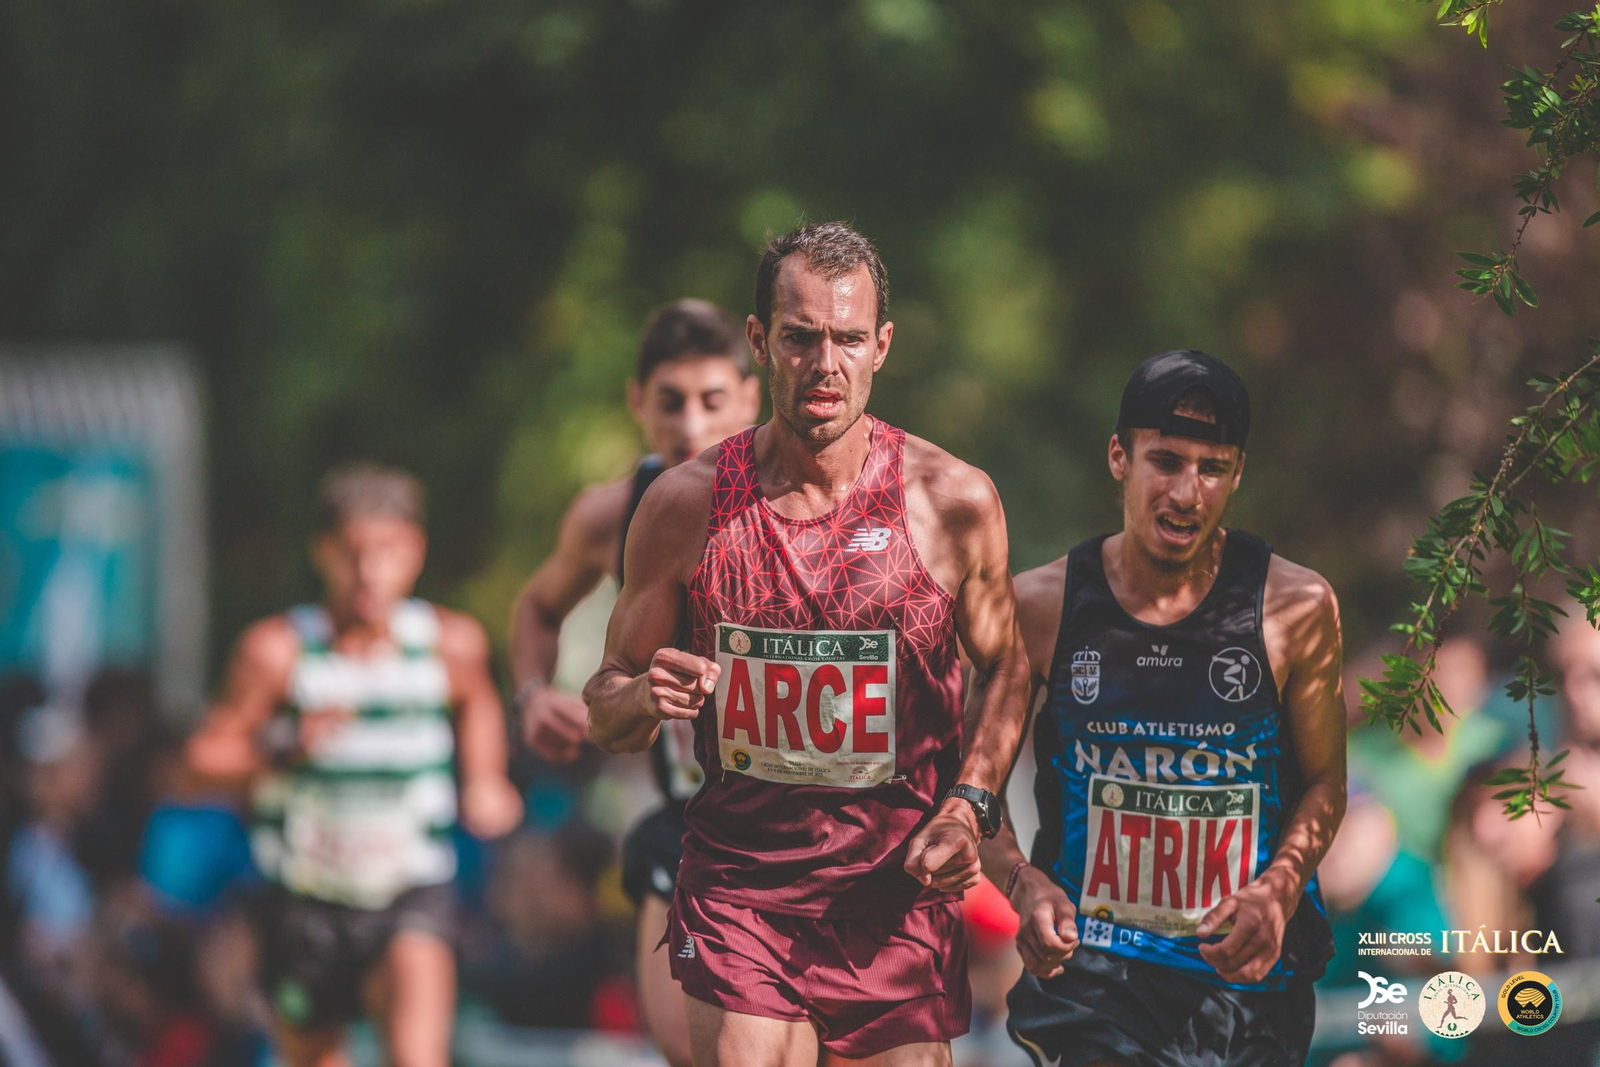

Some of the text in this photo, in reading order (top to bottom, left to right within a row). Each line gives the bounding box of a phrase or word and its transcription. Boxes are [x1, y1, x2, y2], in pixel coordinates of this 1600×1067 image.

[762, 635, 845, 657] ITÁLICA
[1136, 655, 1183, 667] amura
[722, 657, 889, 754] ARCE
[1087, 721, 1236, 736] CLUB ATLETISMO
[1075, 738, 1258, 783] NARÓN
[1135, 790, 1214, 813] ITÁLICA
[1087, 809, 1252, 909] ATRIKI
